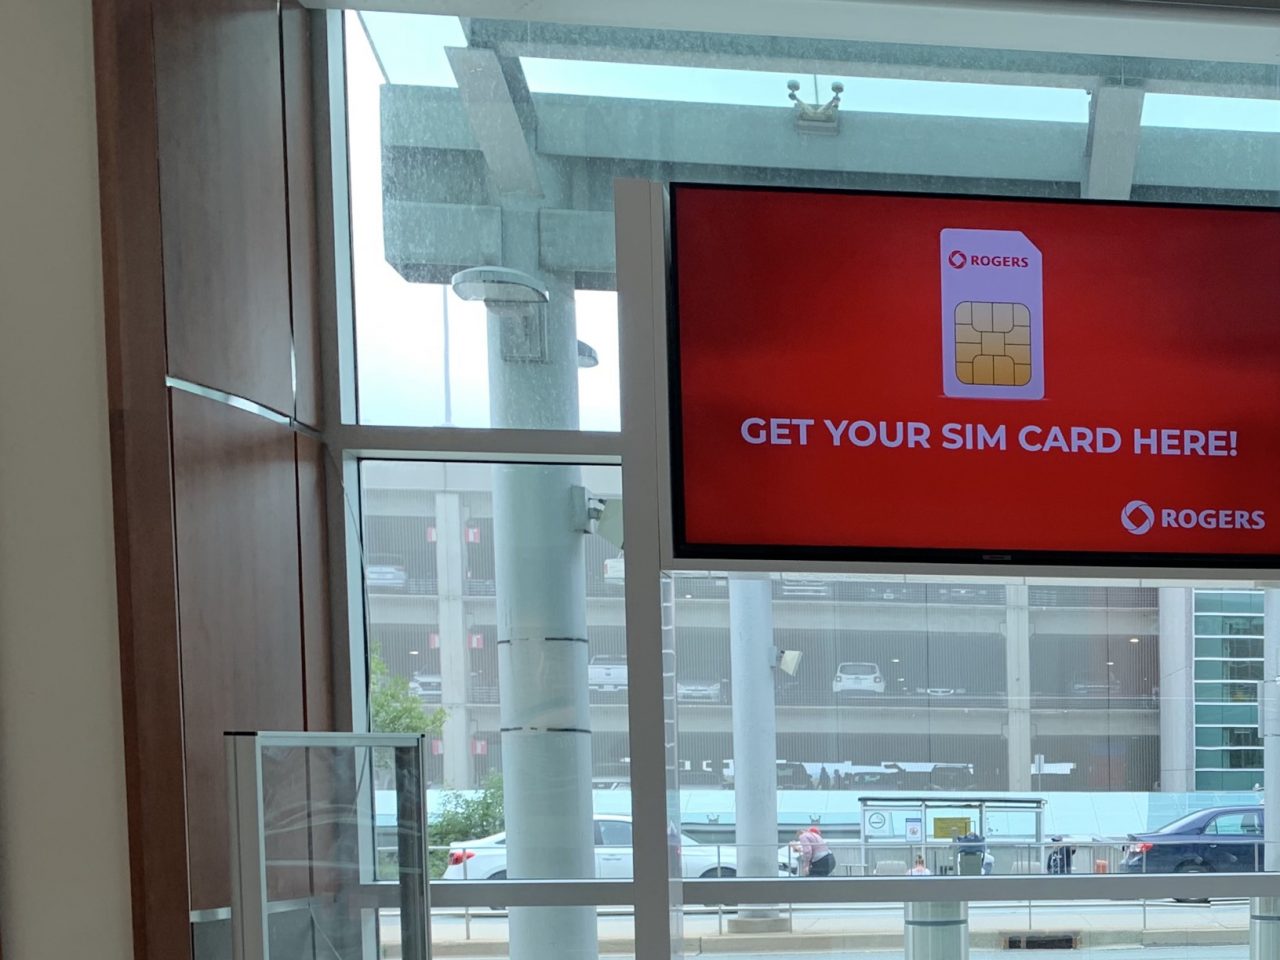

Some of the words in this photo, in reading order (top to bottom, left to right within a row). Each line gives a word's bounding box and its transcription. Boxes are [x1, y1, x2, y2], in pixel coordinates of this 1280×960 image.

[969, 254, 1030, 269] ROGERS
[740, 417, 815, 446] GET
[823, 419, 931, 449] YOUR
[941, 422, 1007, 451] SIM
[1018, 424, 1122, 454] CARD
[1133, 428, 1238, 457] HERE!
[1161, 508, 1266, 530] ROGERS
